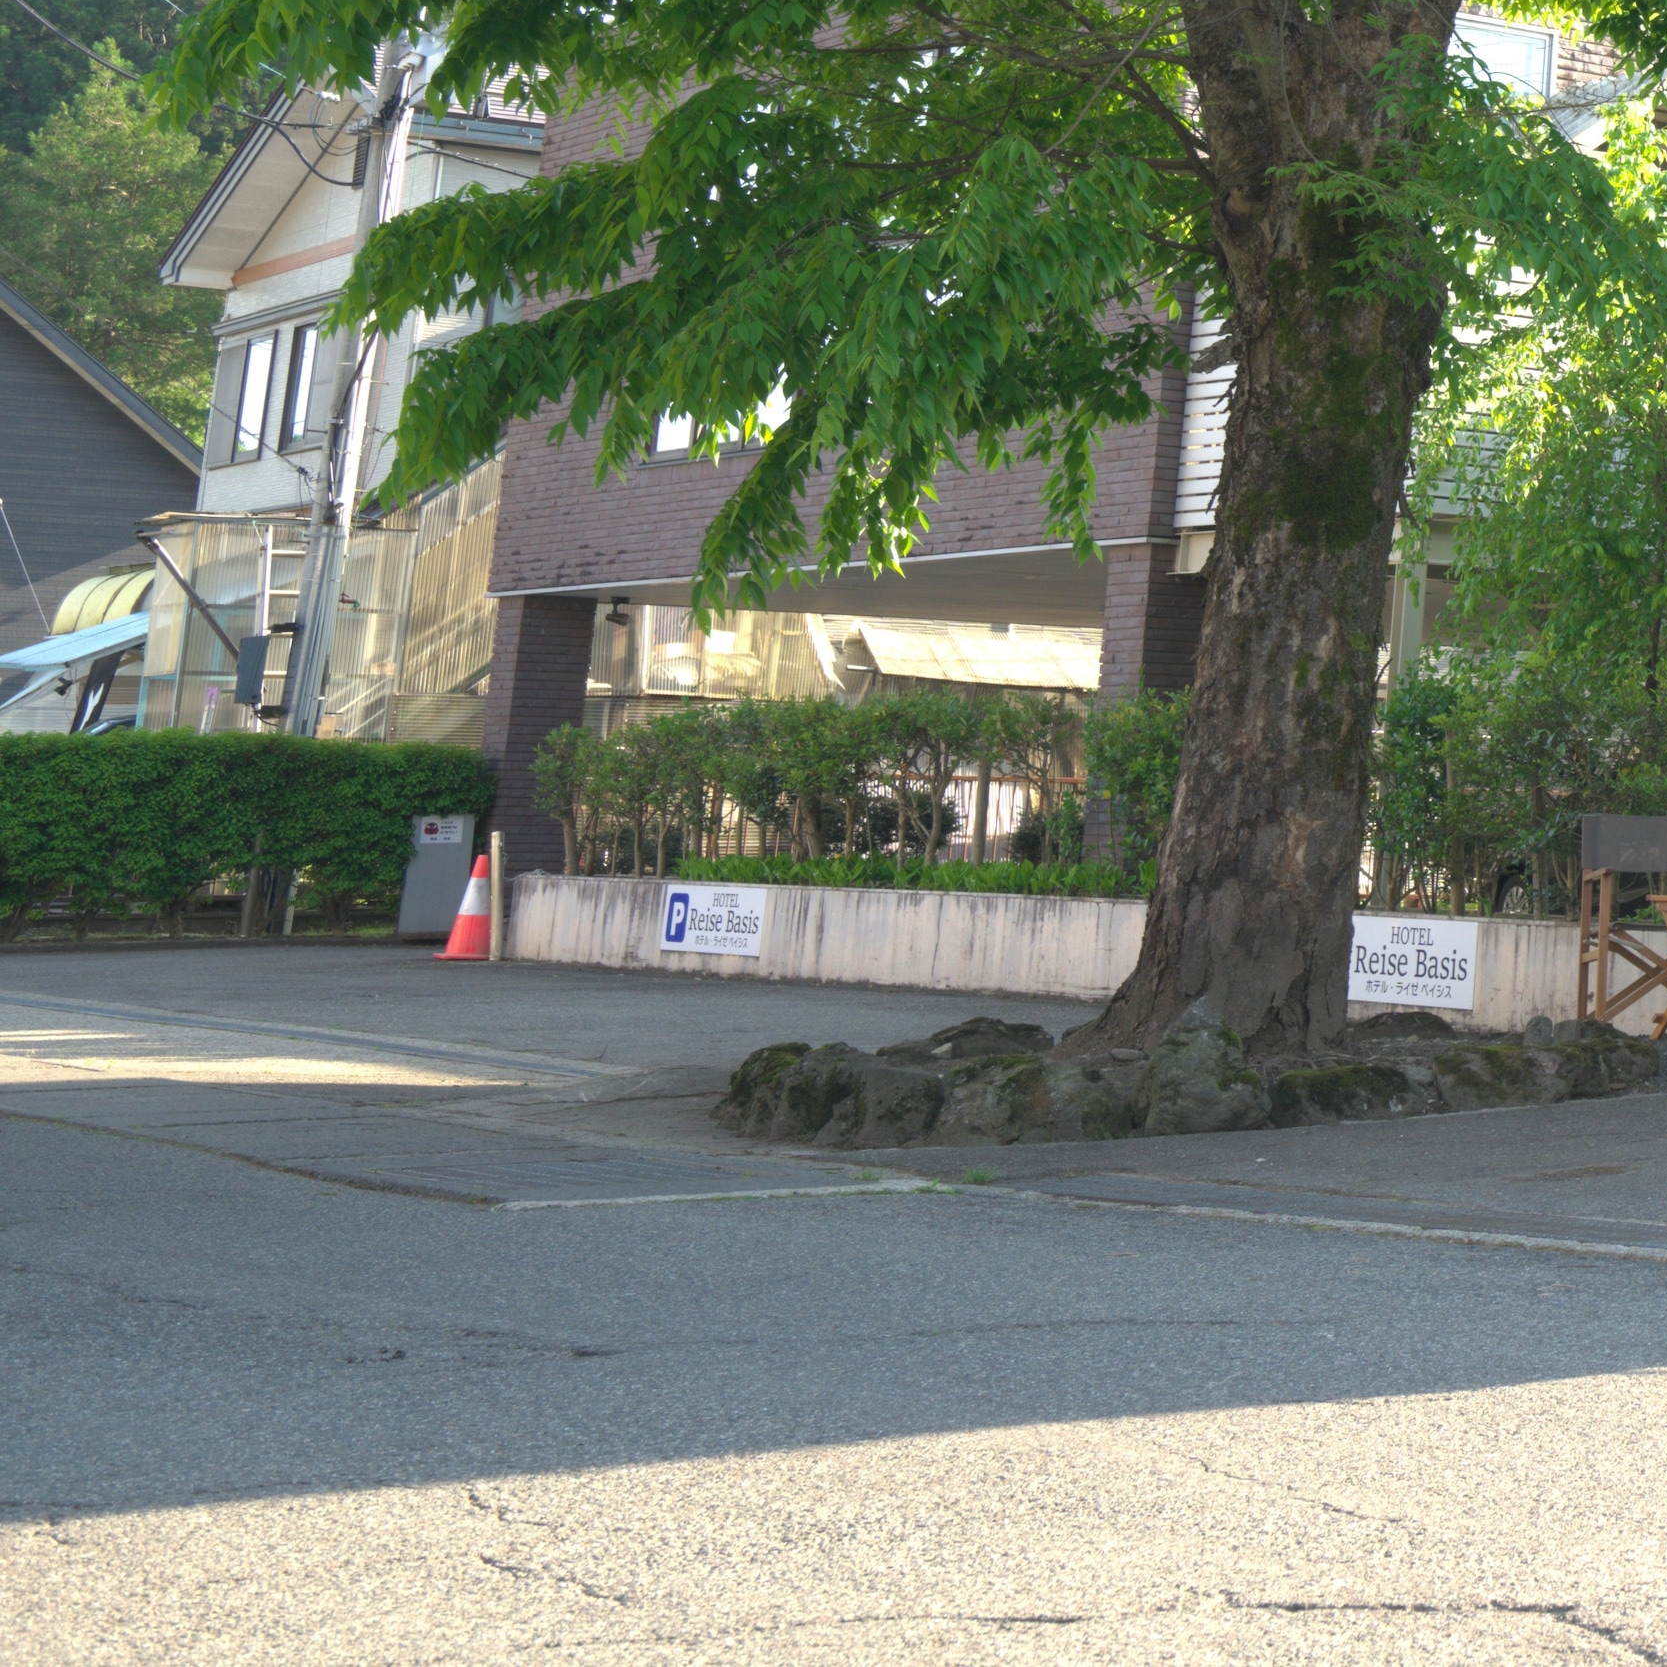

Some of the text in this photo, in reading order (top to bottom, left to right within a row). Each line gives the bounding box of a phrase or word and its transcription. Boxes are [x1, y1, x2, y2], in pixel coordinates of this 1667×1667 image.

[713, 893, 740, 908] HOTEL
[670, 901, 686, 936] P
[689, 908, 760, 934] Reise Basis
[1390, 926, 1434, 946] HOTEL
[1354, 945, 1468, 981] Reise Basis
[1421, 983, 1452, 998] ベイシス
